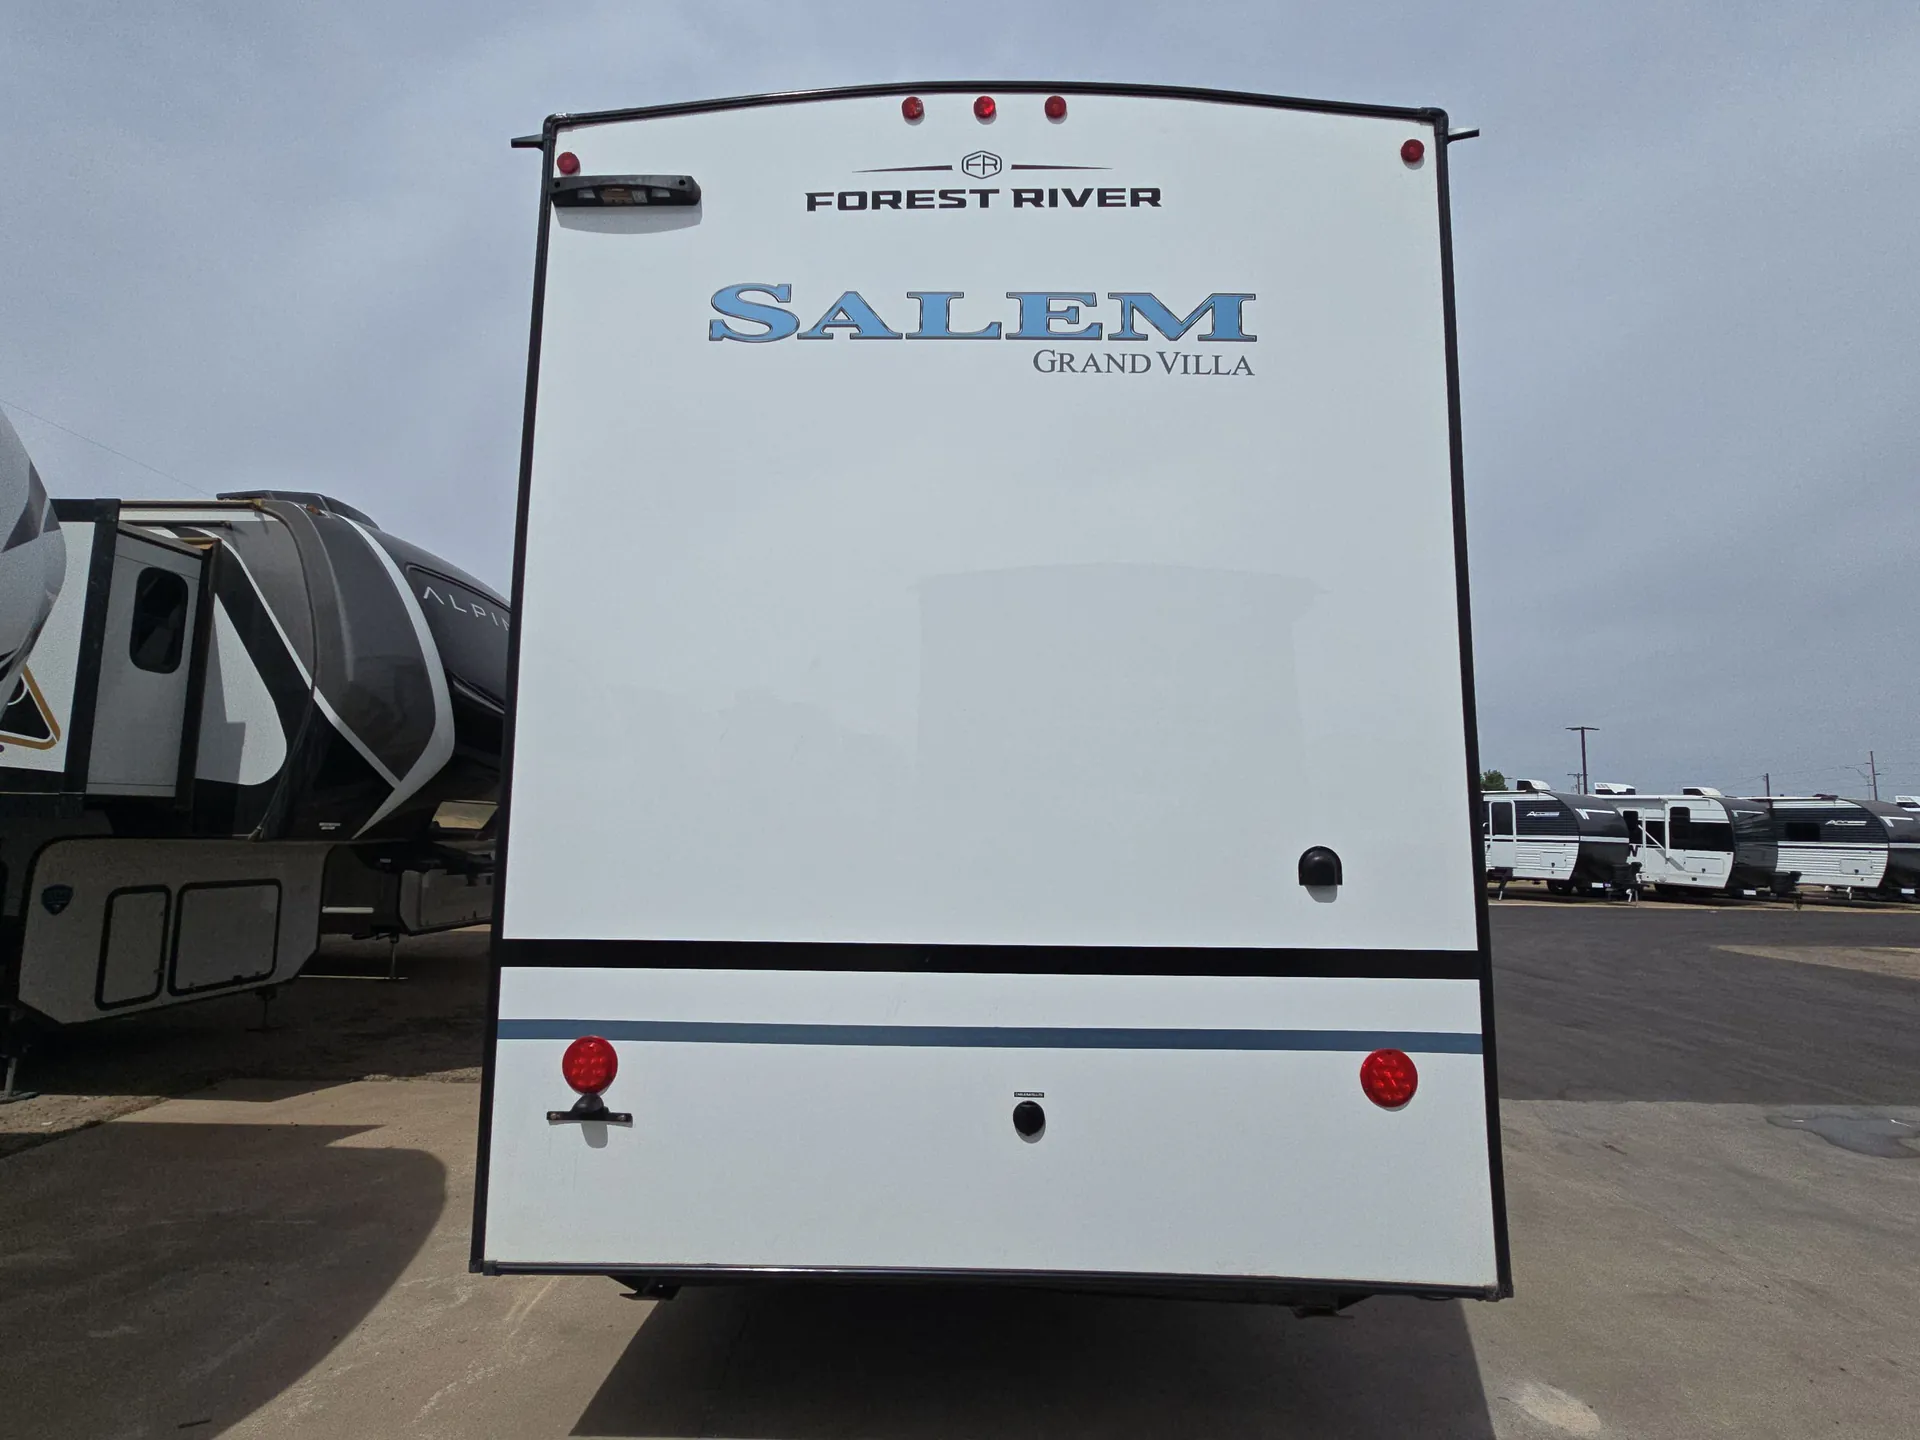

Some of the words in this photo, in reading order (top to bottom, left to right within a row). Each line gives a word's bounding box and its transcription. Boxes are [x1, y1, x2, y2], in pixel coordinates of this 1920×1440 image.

[966, 154, 998, 176] FR
[805, 188, 1000, 212] FOREST
[1011, 187, 1162, 208] RIVER
[709, 283, 1257, 343] SALEM
[1033, 349, 1152, 375] GRAND
[1156, 351, 1255, 376] VILLA
